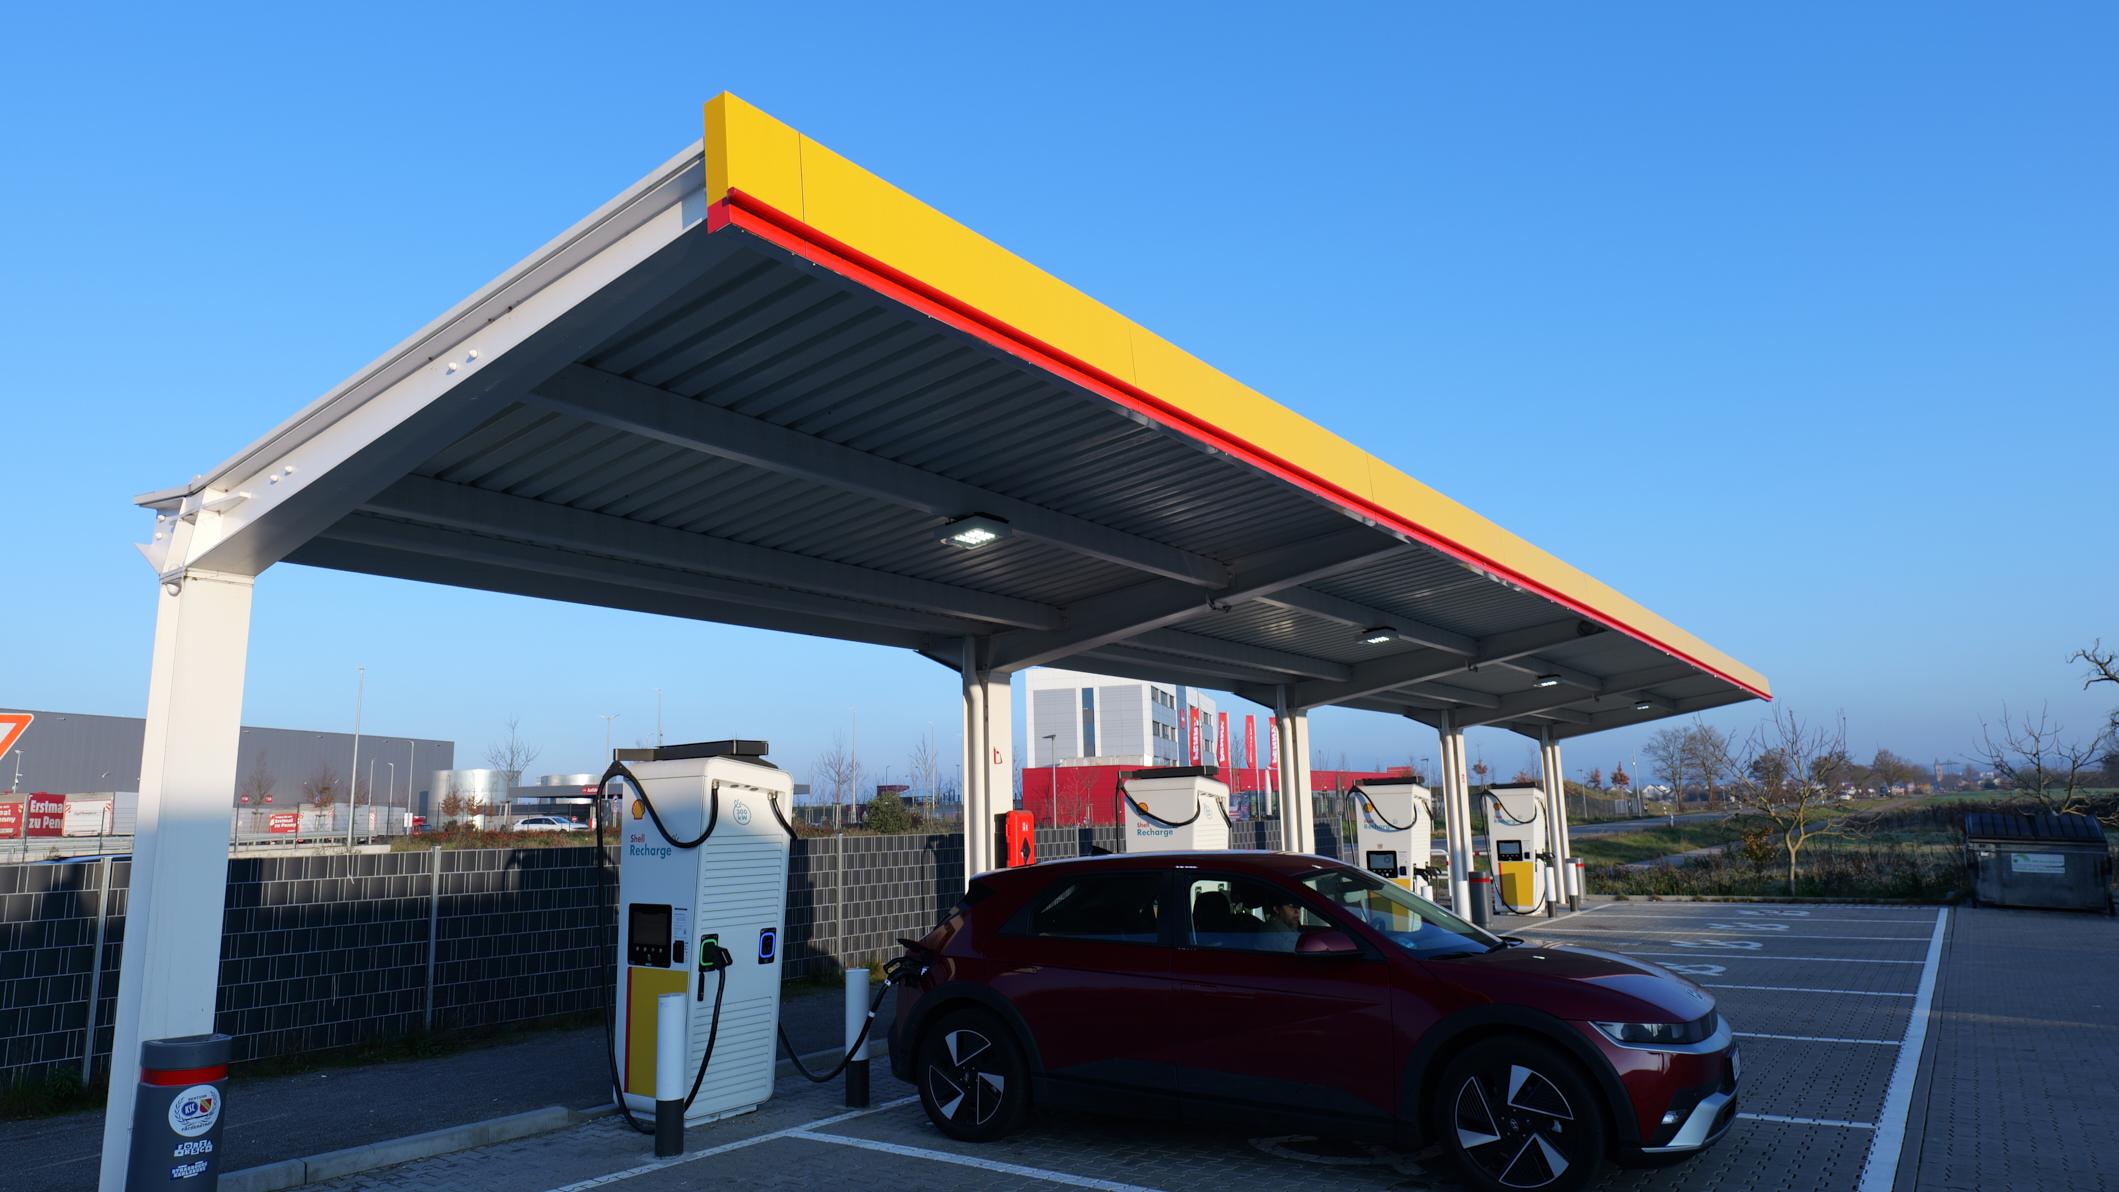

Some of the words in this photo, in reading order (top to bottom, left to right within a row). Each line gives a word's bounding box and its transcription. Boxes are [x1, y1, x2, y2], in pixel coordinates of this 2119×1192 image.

[30, 800, 63, 813] Erstma
[28, 818, 41, 828] zu
[43, 816, 62, 828] Pen
[630, 834, 645, 843] Shell
[1137, 828, 1173, 837] Recharge
[630, 843, 672, 860] Recharge
